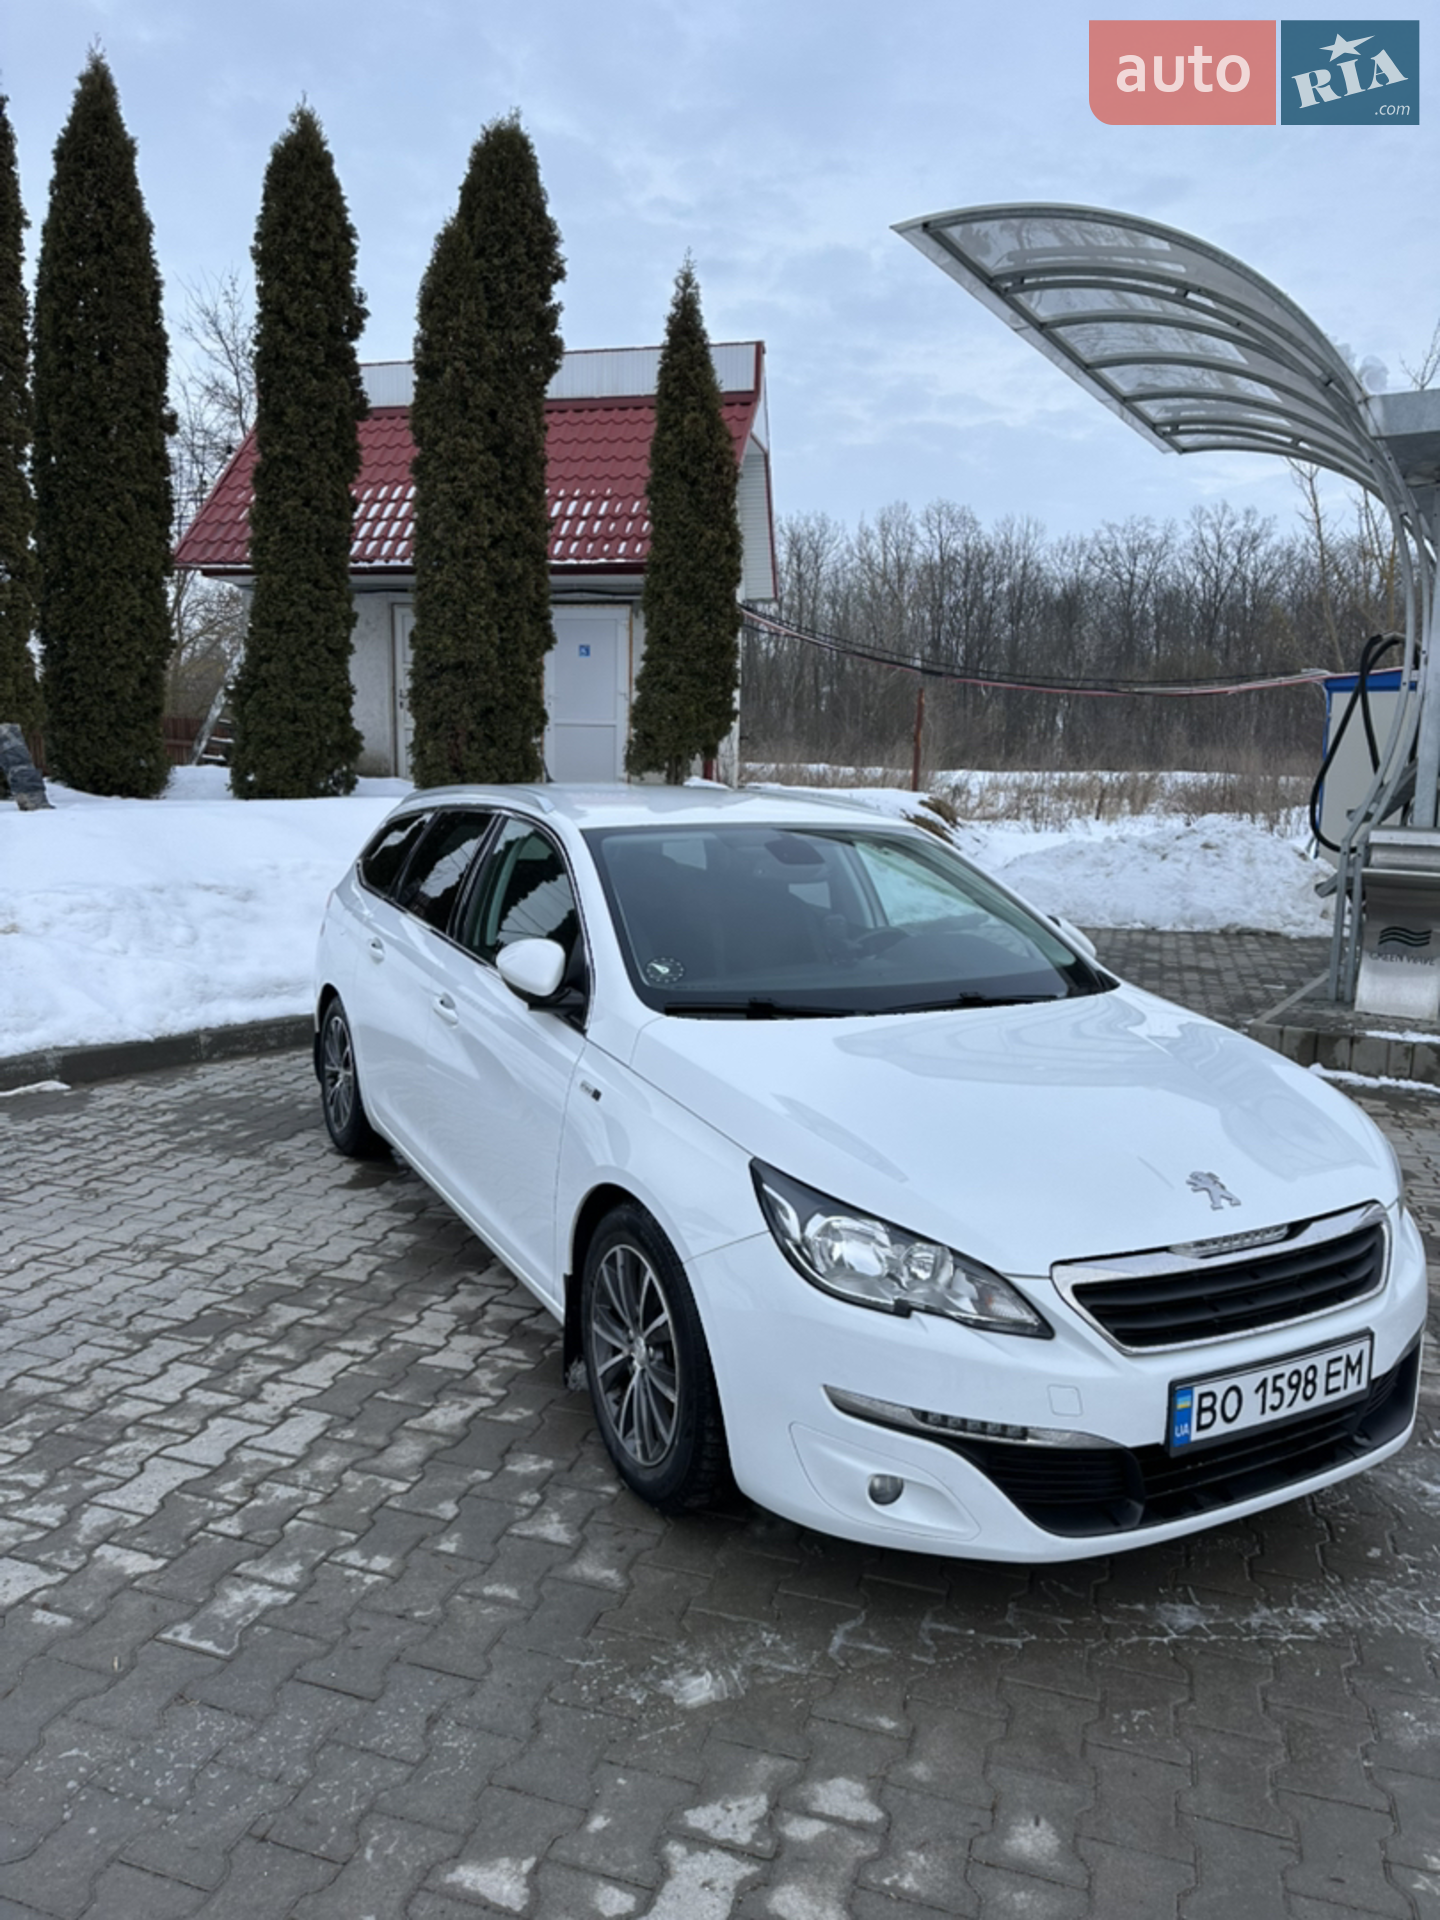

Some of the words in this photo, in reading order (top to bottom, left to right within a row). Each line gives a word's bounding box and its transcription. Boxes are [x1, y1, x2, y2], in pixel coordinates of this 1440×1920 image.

[1196, 1384, 1243, 1432] BO
[1254, 1364, 1318, 1415] 1598
[1324, 1348, 1364, 1396] EM
[1174, 1423, 1190, 1437] UA
